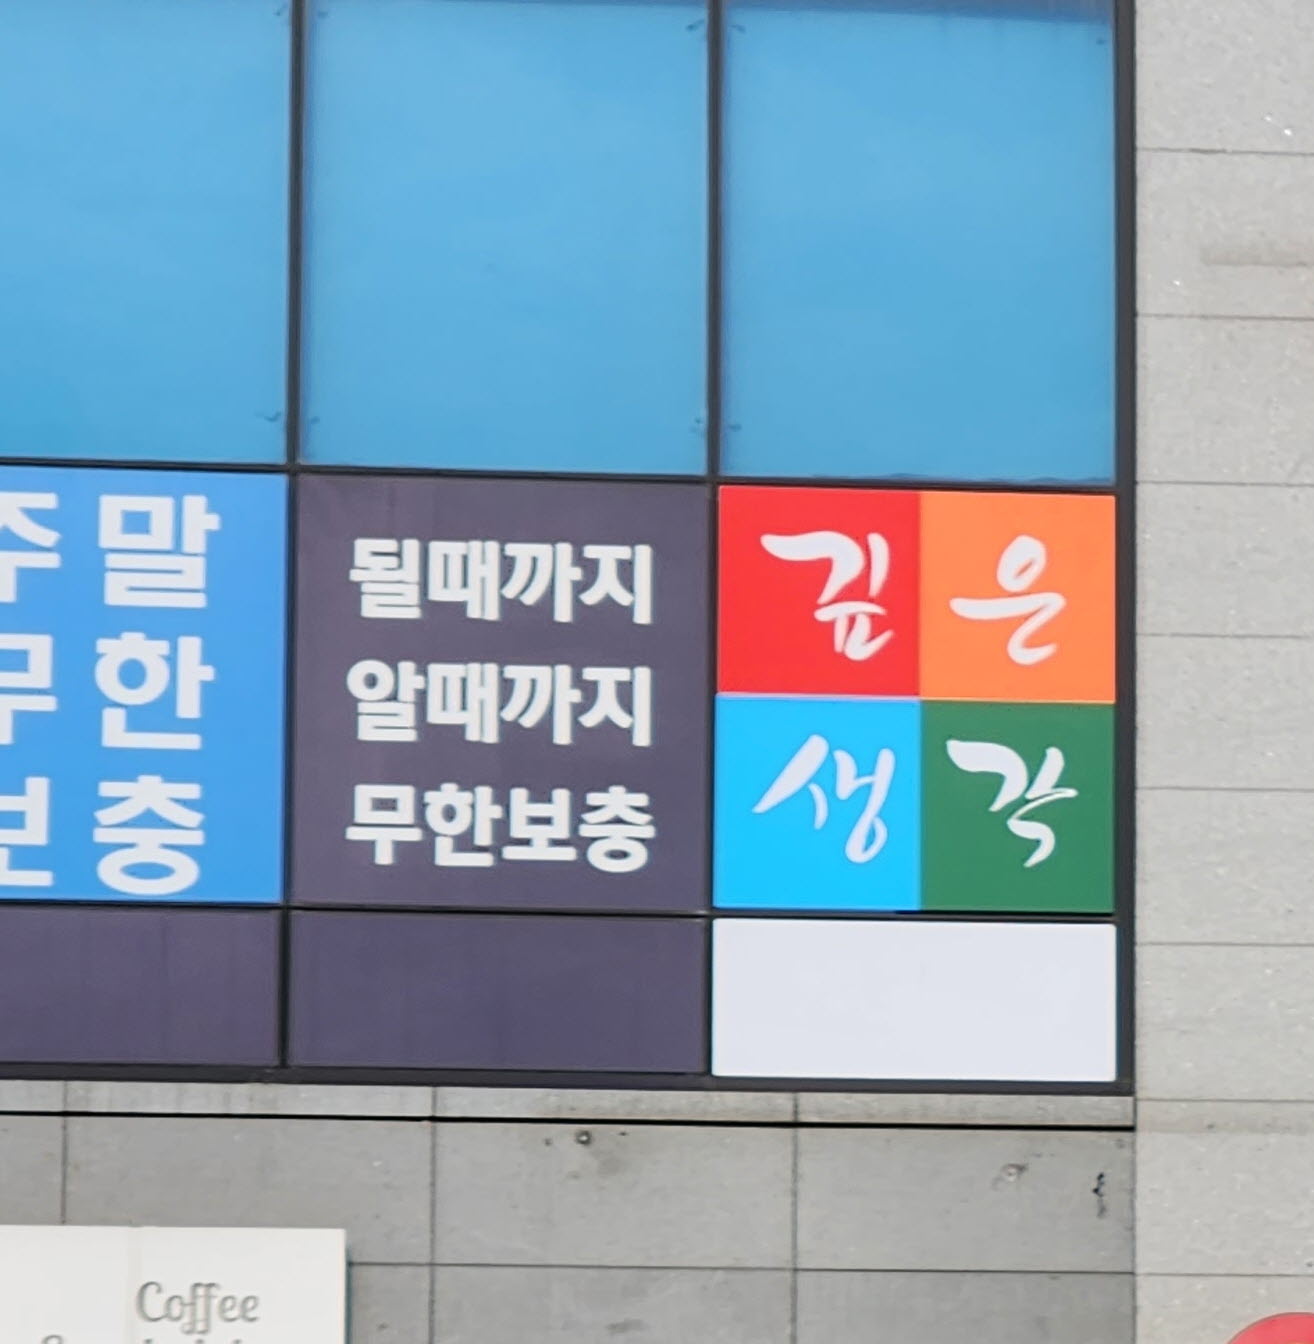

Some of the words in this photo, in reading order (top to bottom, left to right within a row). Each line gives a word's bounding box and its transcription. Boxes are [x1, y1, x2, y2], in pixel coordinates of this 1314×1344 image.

[348, 538, 654, 624] 될때까지
[346, 659, 653, 747] 알때까지
[345, 784, 657, 874] 무한보충
[752, 734, 1078, 868] 생각
[136, 1281, 260, 1335] Coffee
